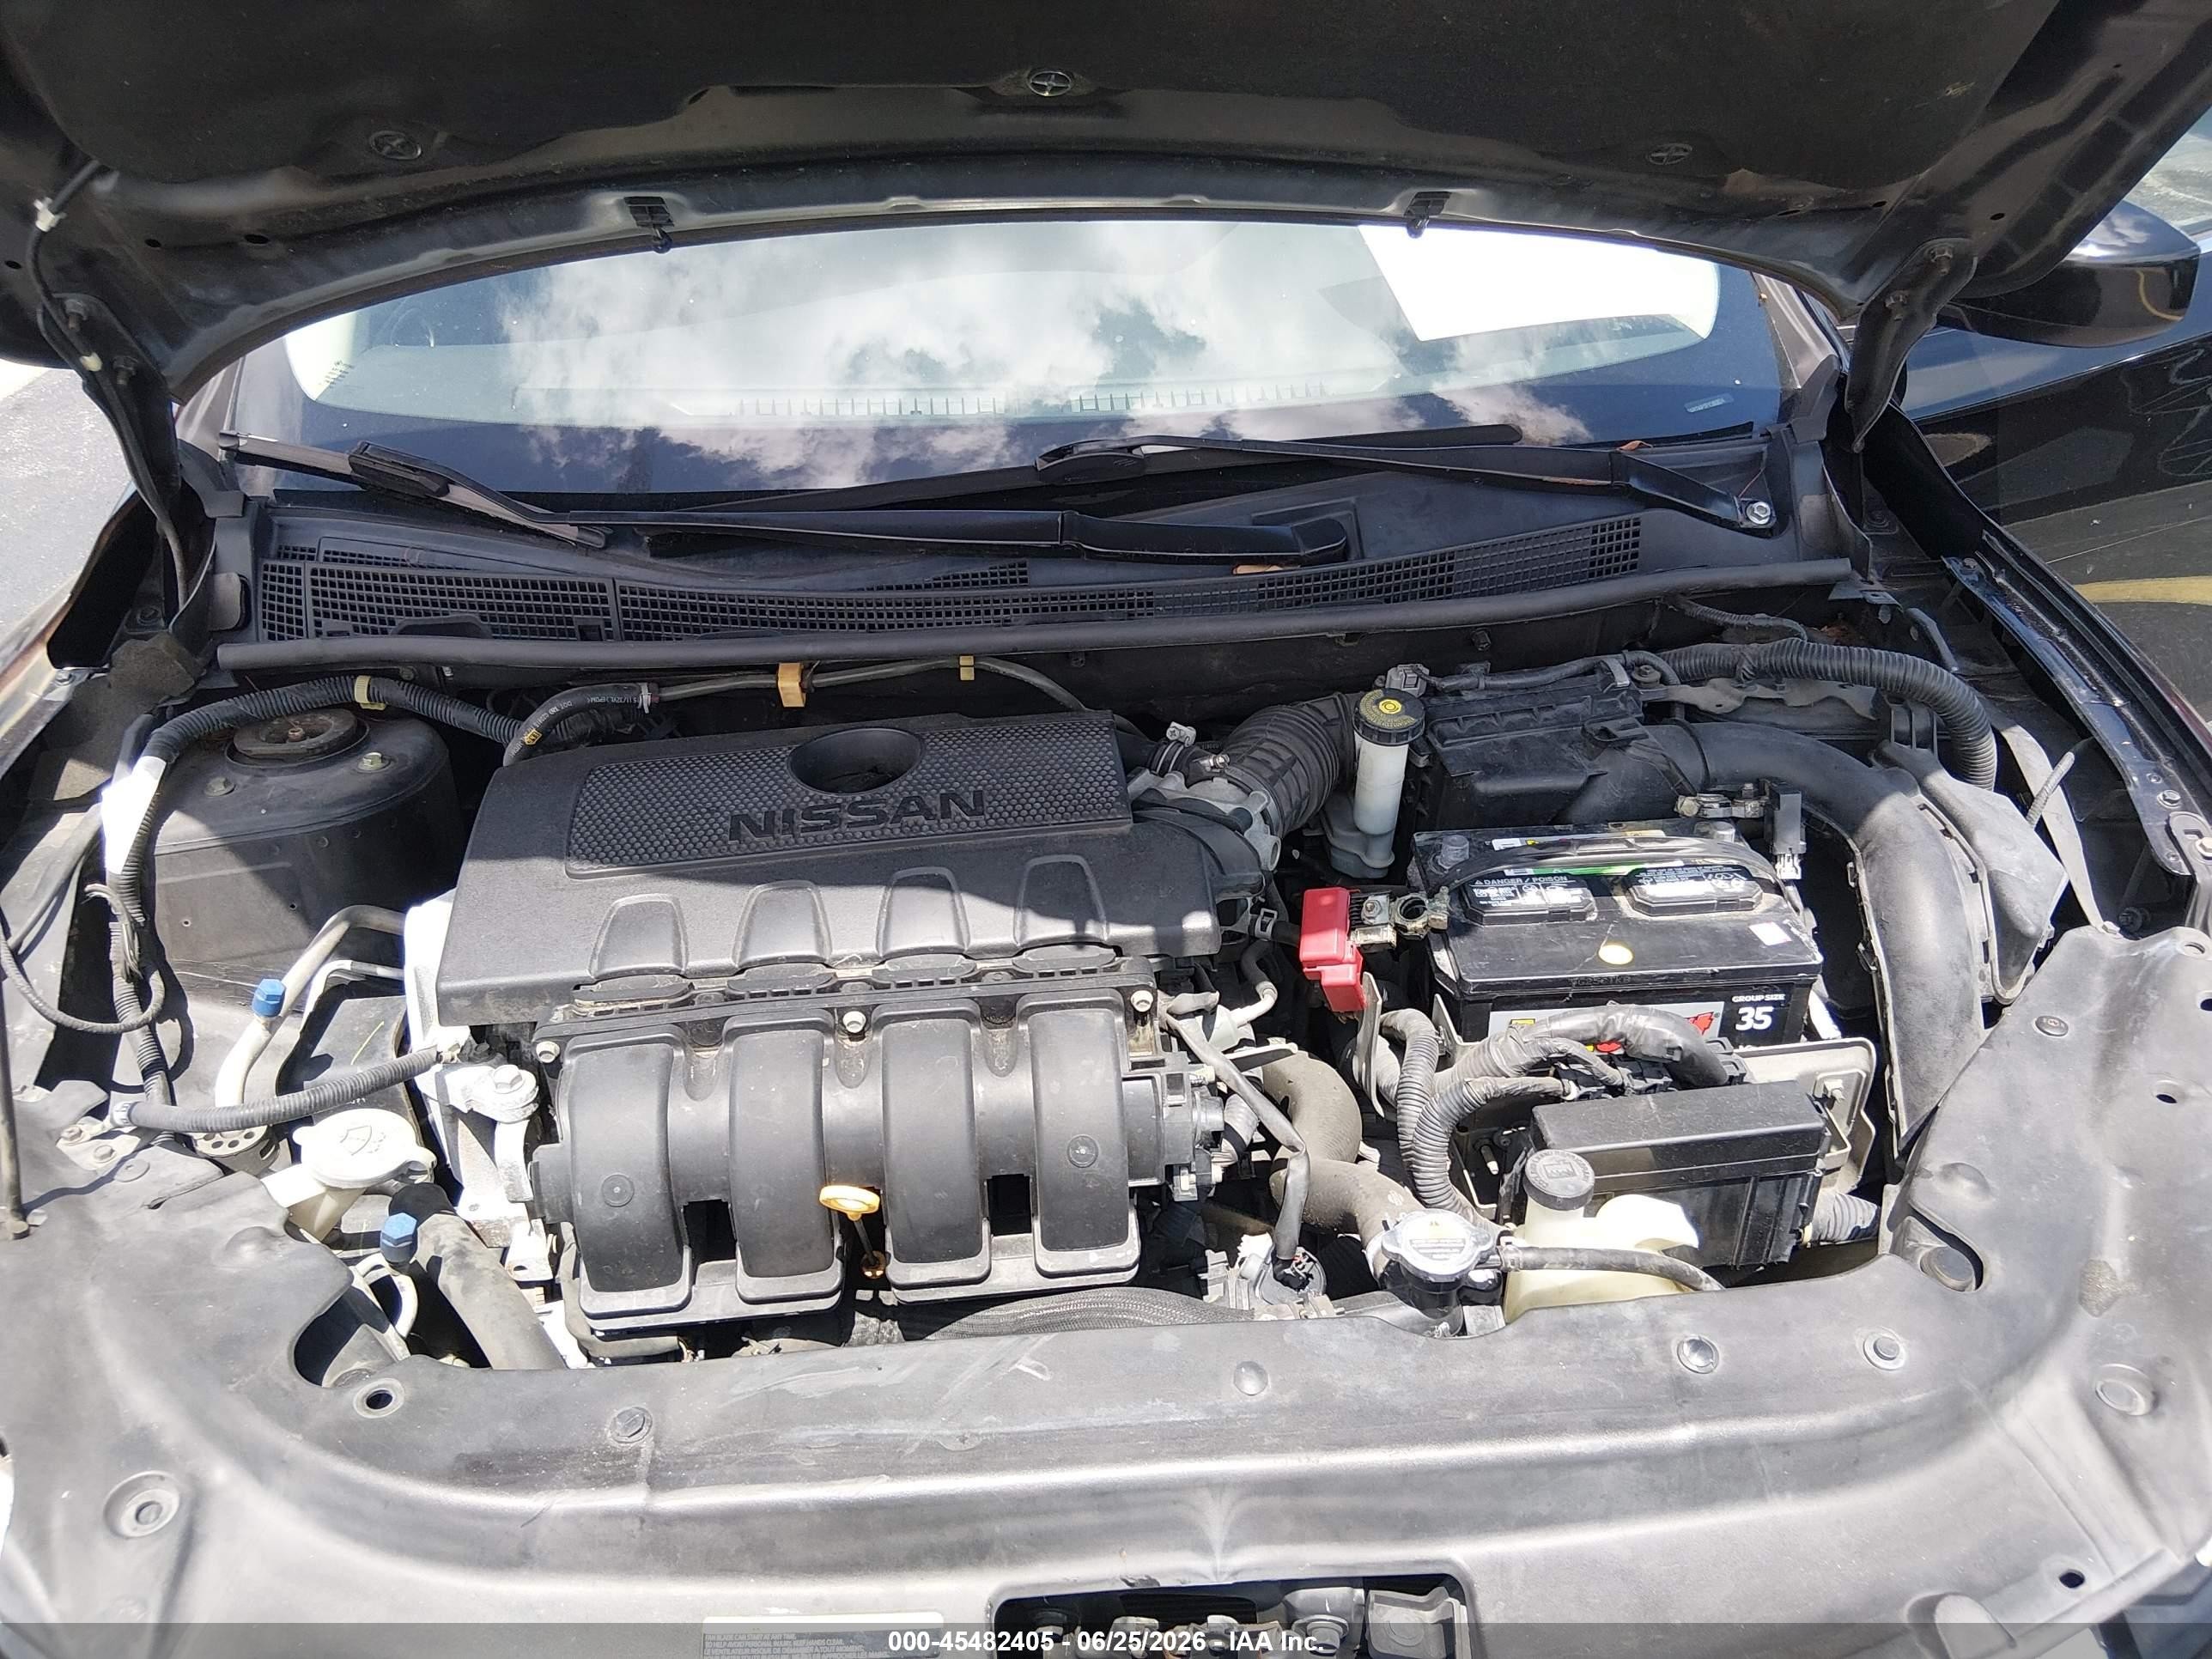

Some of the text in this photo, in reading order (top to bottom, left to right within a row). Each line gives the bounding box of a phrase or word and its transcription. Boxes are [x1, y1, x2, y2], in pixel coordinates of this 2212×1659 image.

[728, 789, 986, 845] NISSAN
[1533, 875, 1568, 884] POISON
[1732, 993, 1785, 1003] GROUP SIZE
[1735, 1006, 1775, 1031] 35
